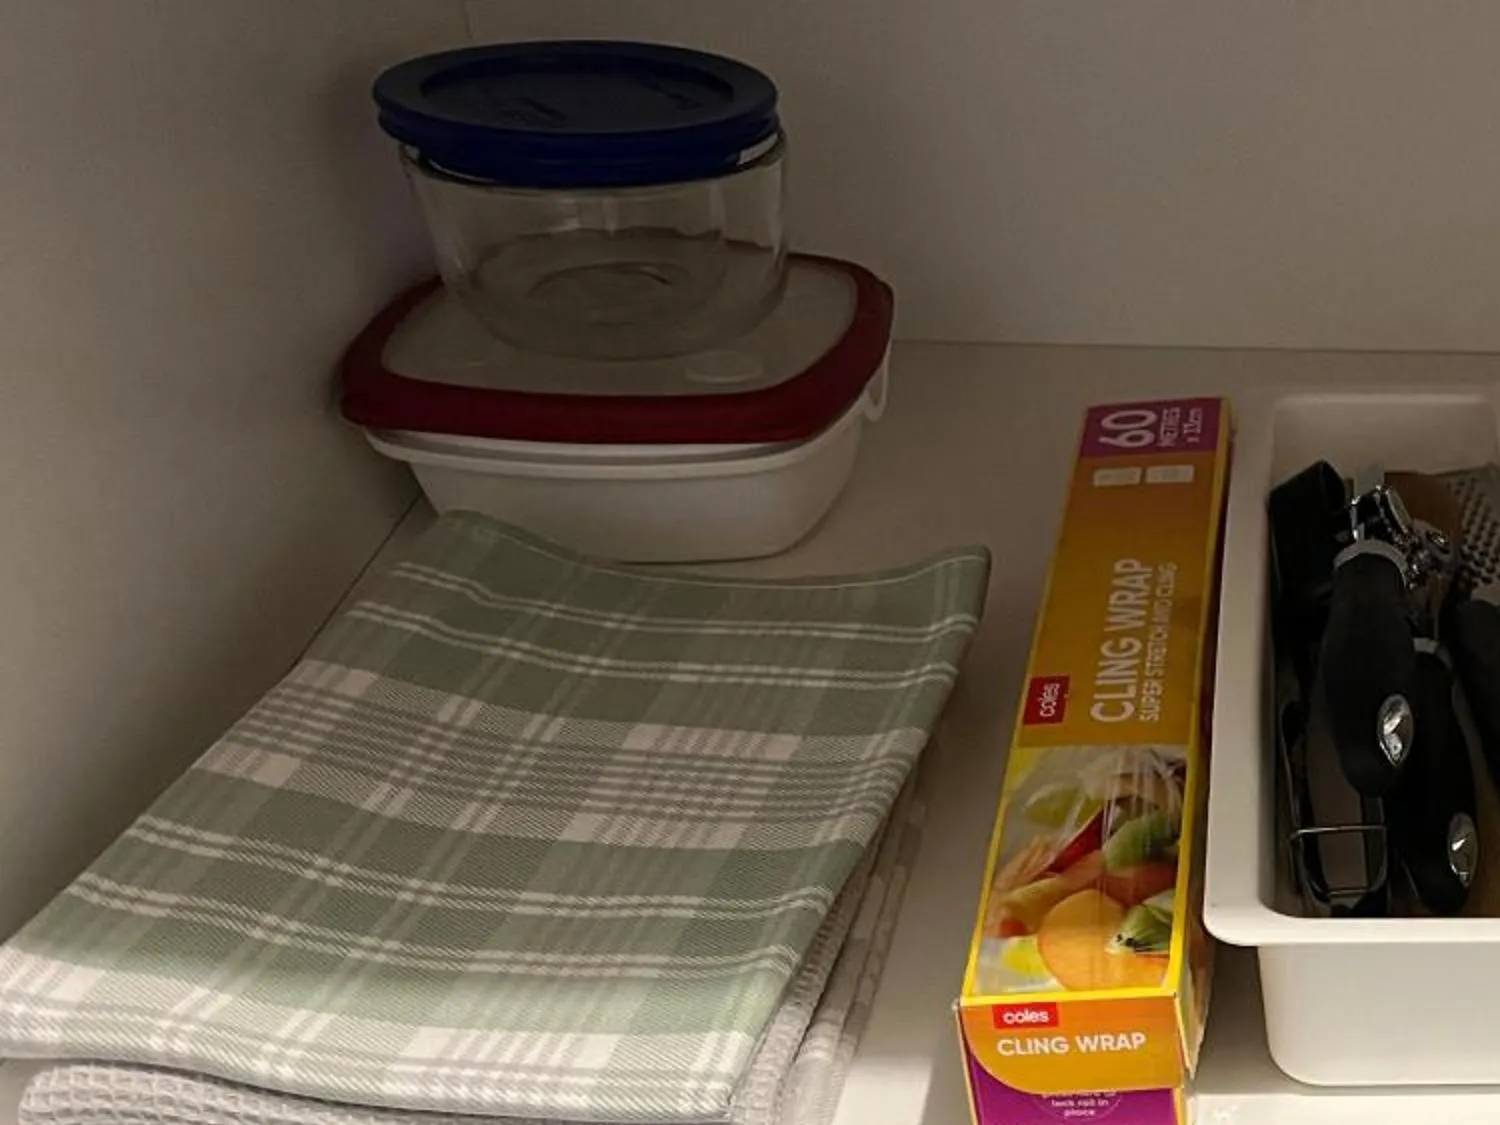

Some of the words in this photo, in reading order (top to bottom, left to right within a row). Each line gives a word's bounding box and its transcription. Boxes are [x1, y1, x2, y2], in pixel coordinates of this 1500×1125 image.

[1098, 409, 1158, 447] 60
[1104, 558, 1153, 632] WRAP
[1090, 636, 1142, 722] CLING
[1038, 682, 1061, 718] coles
[1003, 1008, 1049, 1024] coles
[997, 1036, 1070, 1056] CLING
[1076, 1032, 1146, 1053] WRAP
